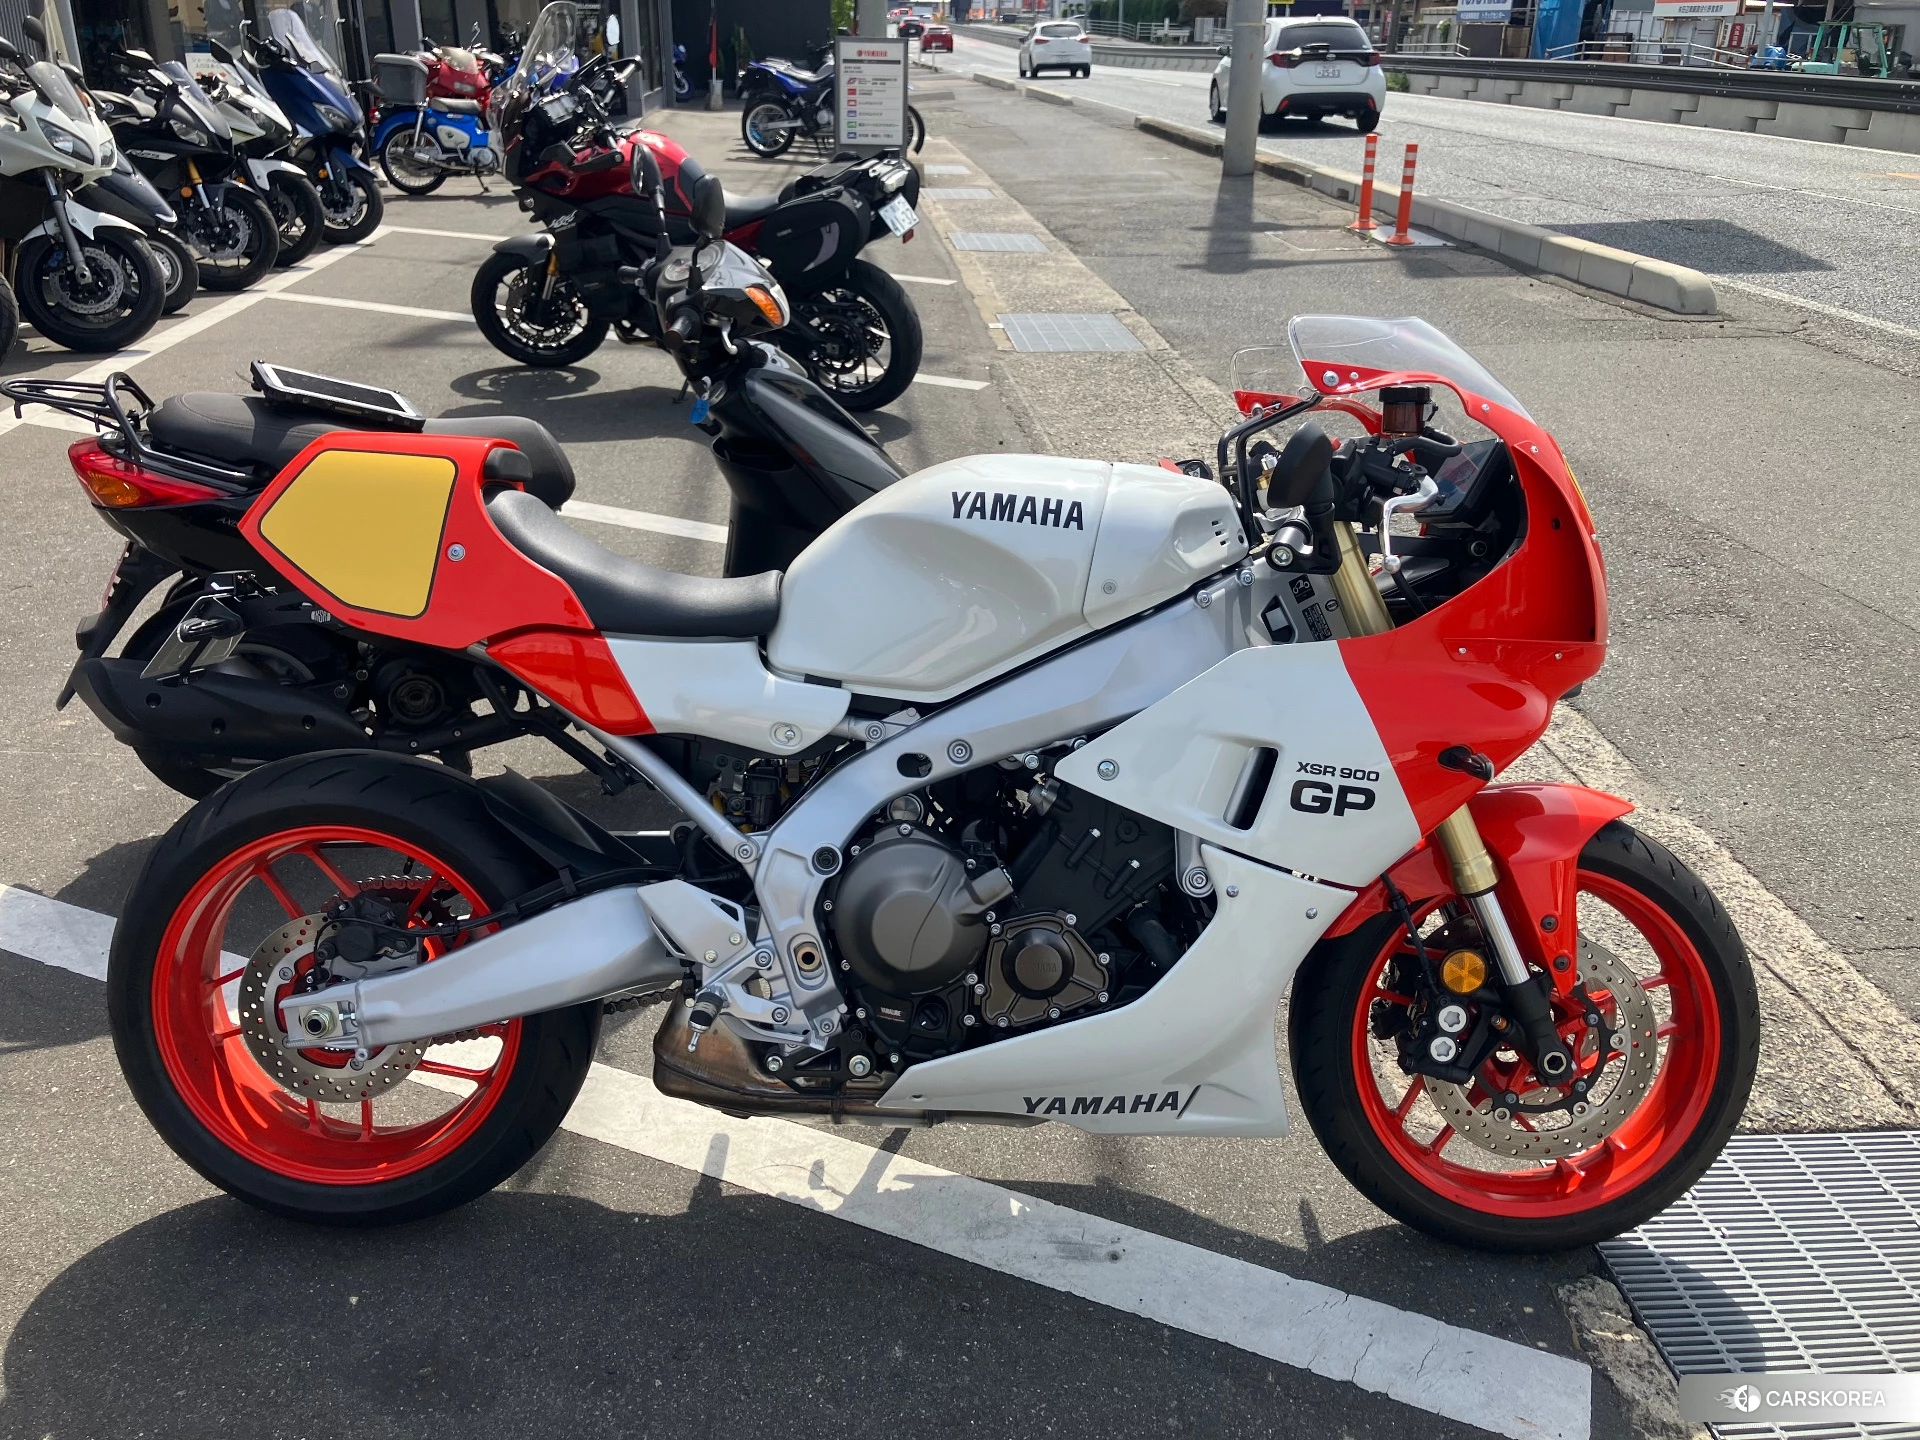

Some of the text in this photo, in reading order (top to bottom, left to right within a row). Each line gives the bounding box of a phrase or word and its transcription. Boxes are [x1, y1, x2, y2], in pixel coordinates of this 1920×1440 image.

[952, 491, 1083, 531] YAMAHA
[1296, 761, 1380, 782] XSR 900
[1290, 779, 1376, 817] GP
[1023, 1091, 1179, 1115] YAMAHA
